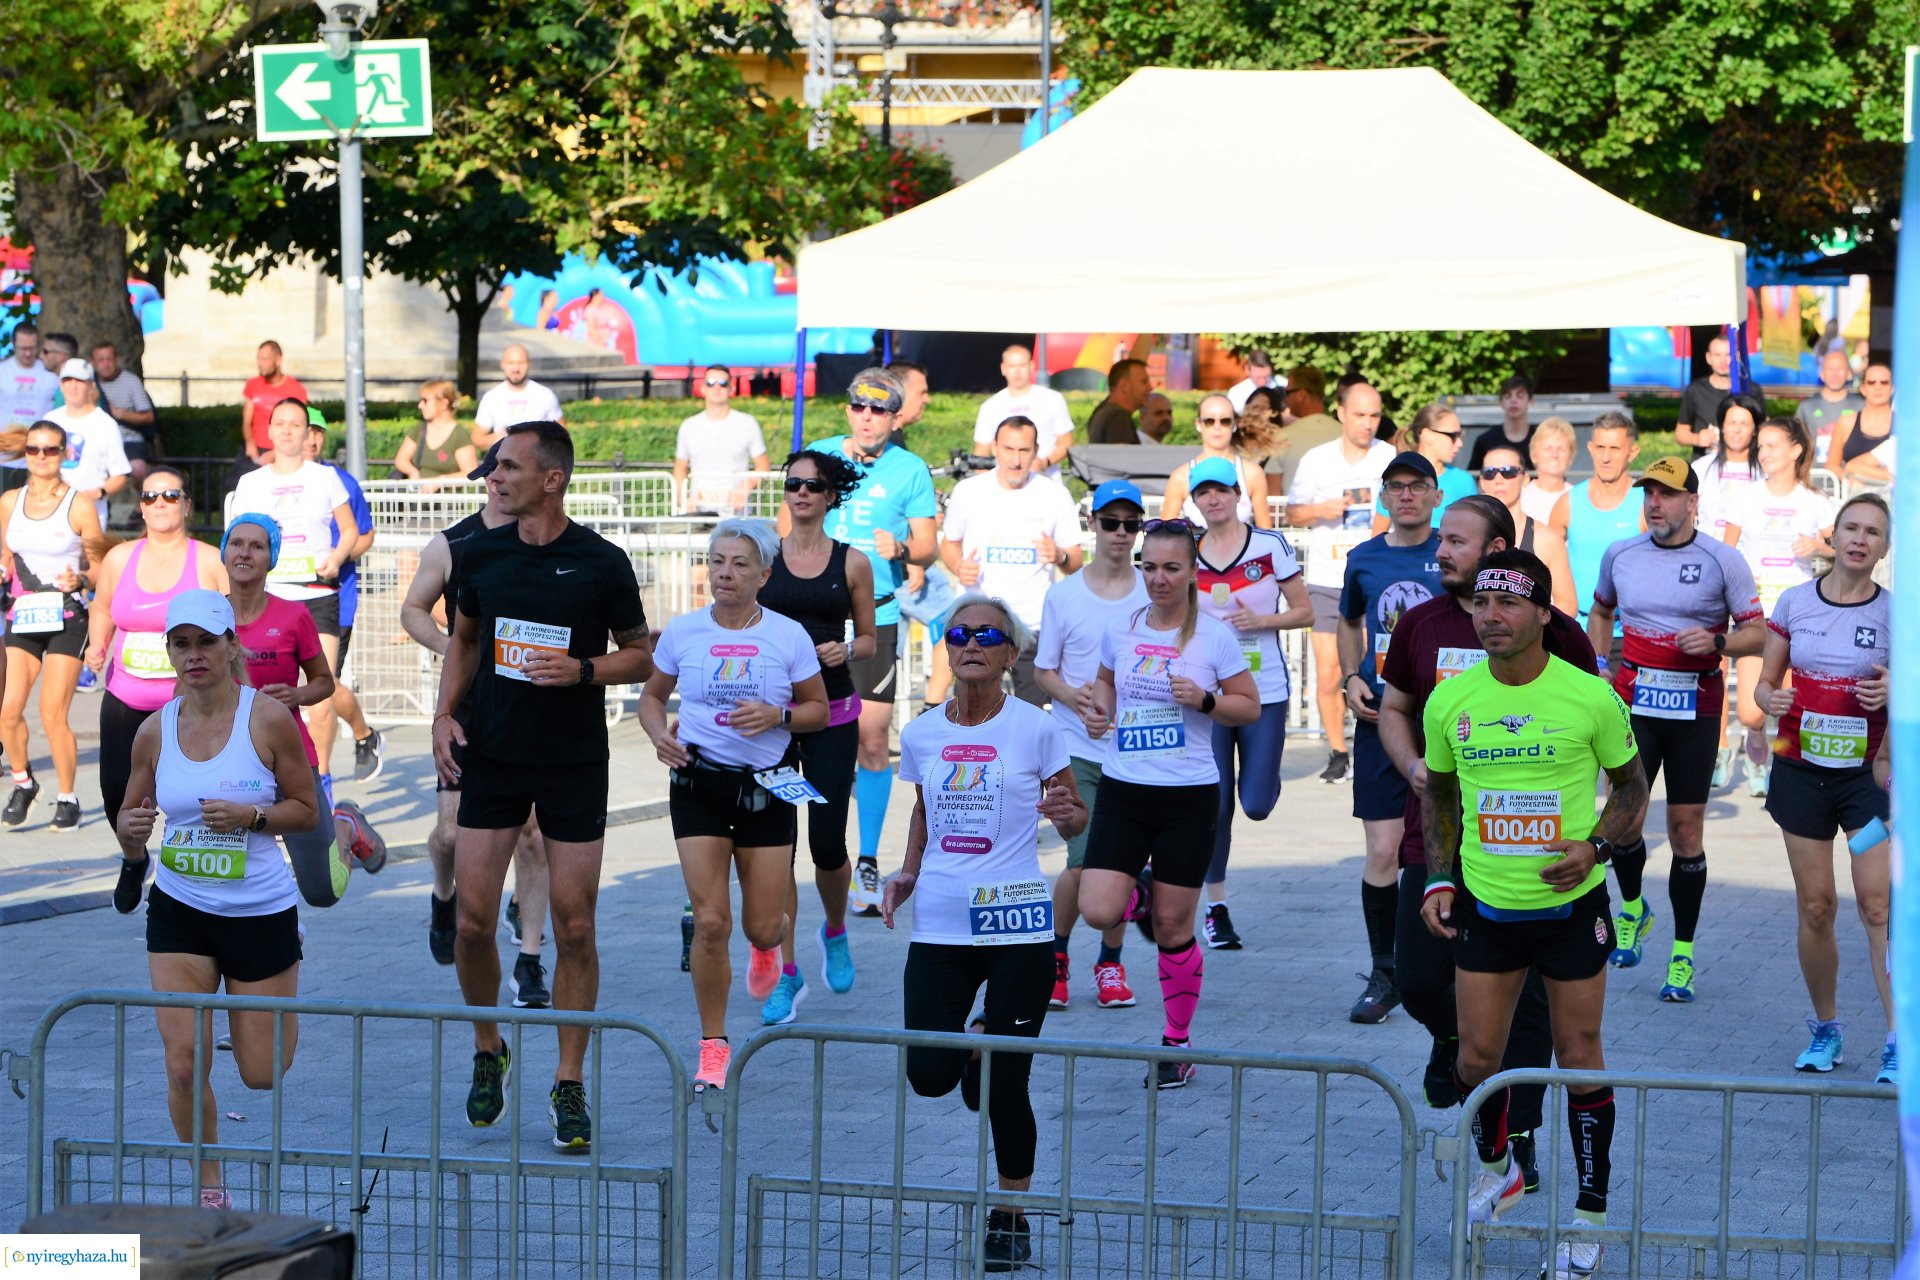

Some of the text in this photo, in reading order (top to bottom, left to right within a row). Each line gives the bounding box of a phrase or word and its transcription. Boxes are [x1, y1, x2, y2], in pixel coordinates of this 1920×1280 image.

[1637, 688, 1690, 709] 21001
[1122, 727, 1179, 749] 21150
[1809, 735, 1857, 757] 5132
[1461, 743, 1540, 761] Gepard
[220, 780, 261, 788] FLOW
[937, 802, 994, 811] FUTÓFESZTIVÁL
[945, 793, 994, 802] NYÍREGYHÁZI
[197, 835, 245, 843] FUTÓFESZTIVÁL
[1483, 818, 1556, 842] 10040
[174, 851, 233, 876] 5100
[1003, 888, 1048, 898] FUTÓFESZTIVÁL
[978, 905, 1046, 932] 21013
